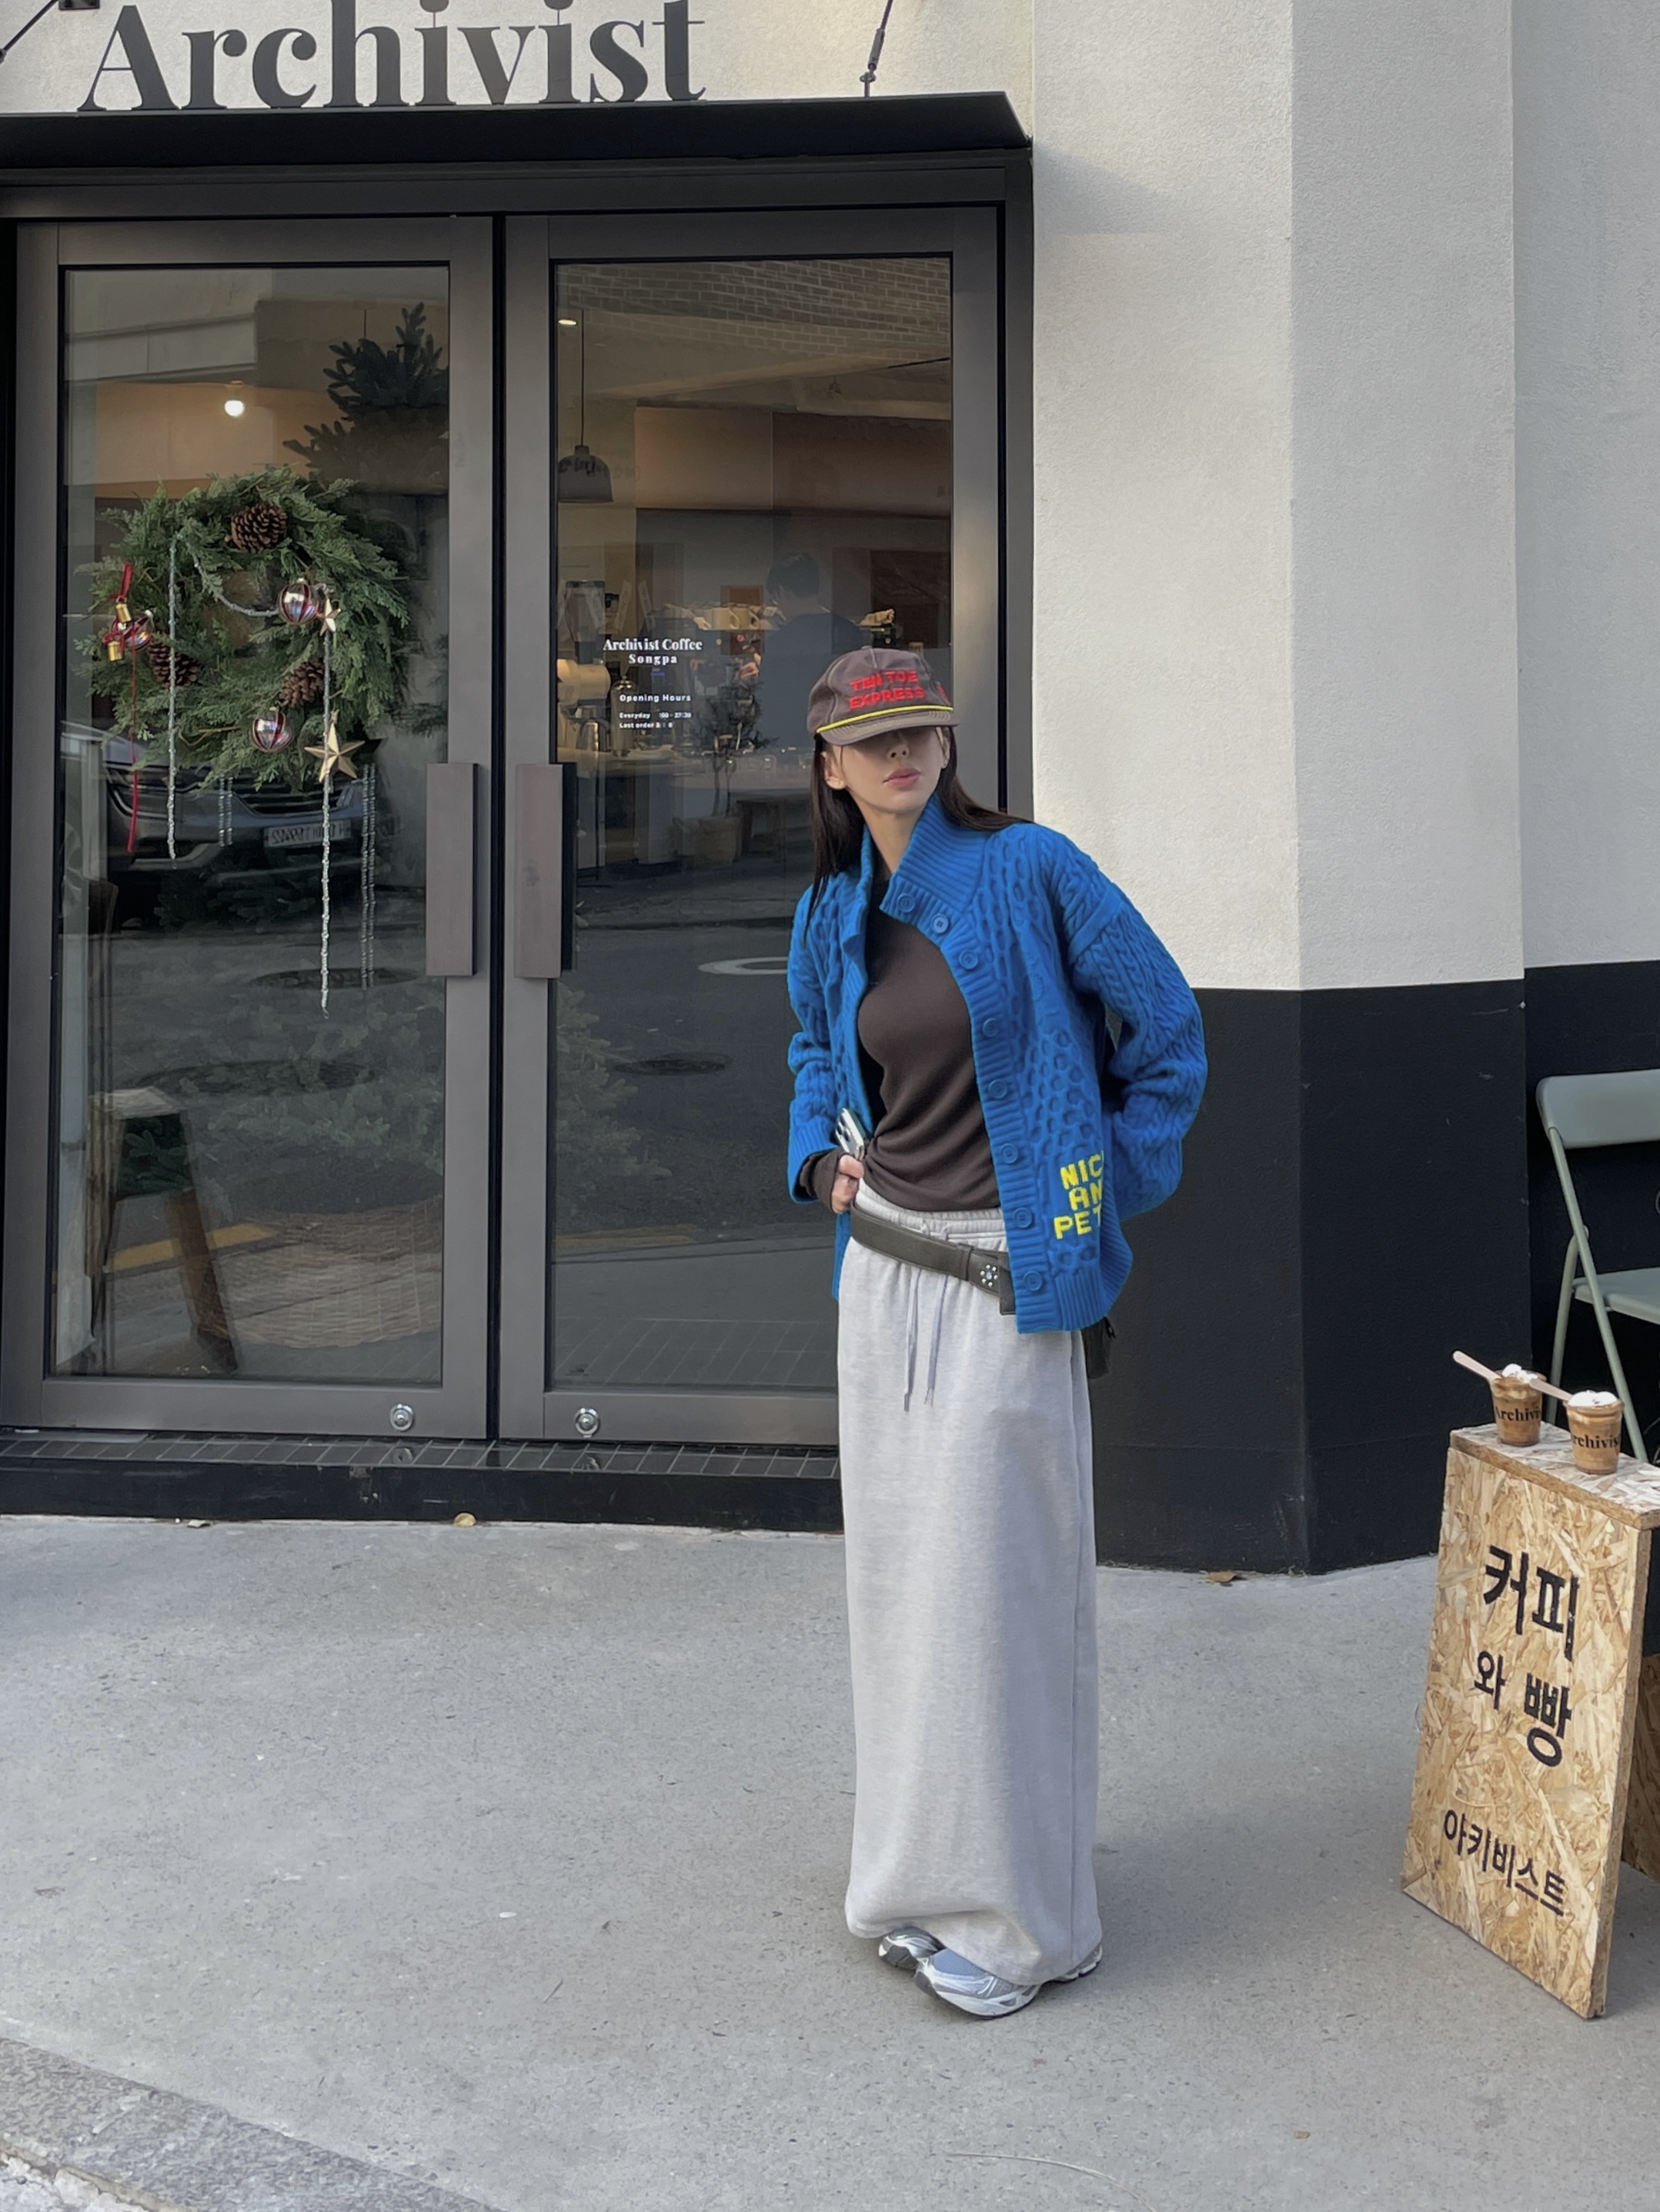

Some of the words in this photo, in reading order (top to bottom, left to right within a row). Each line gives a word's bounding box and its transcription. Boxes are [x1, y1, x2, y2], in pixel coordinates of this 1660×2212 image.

[77, 0, 706, 112] Archivist
[603, 638, 660, 651] Archivist
[628, 654, 677, 666] Songpa
[850, 673, 883, 691] TEN
[885, 671, 918, 683] TOE
[620, 694, 660, 702] Opening
[850, 686, 926, 709] EXPRESS
[1060, 1150, 1104, 1189] NIC
[1483, 1544, 1581, 1662] 커피
[1475, 1650, 1505, 1710] 와
[1524, 1672, 1571, 1767] 빵
[1444, 1810, 1565, 1917] 아키비스트
